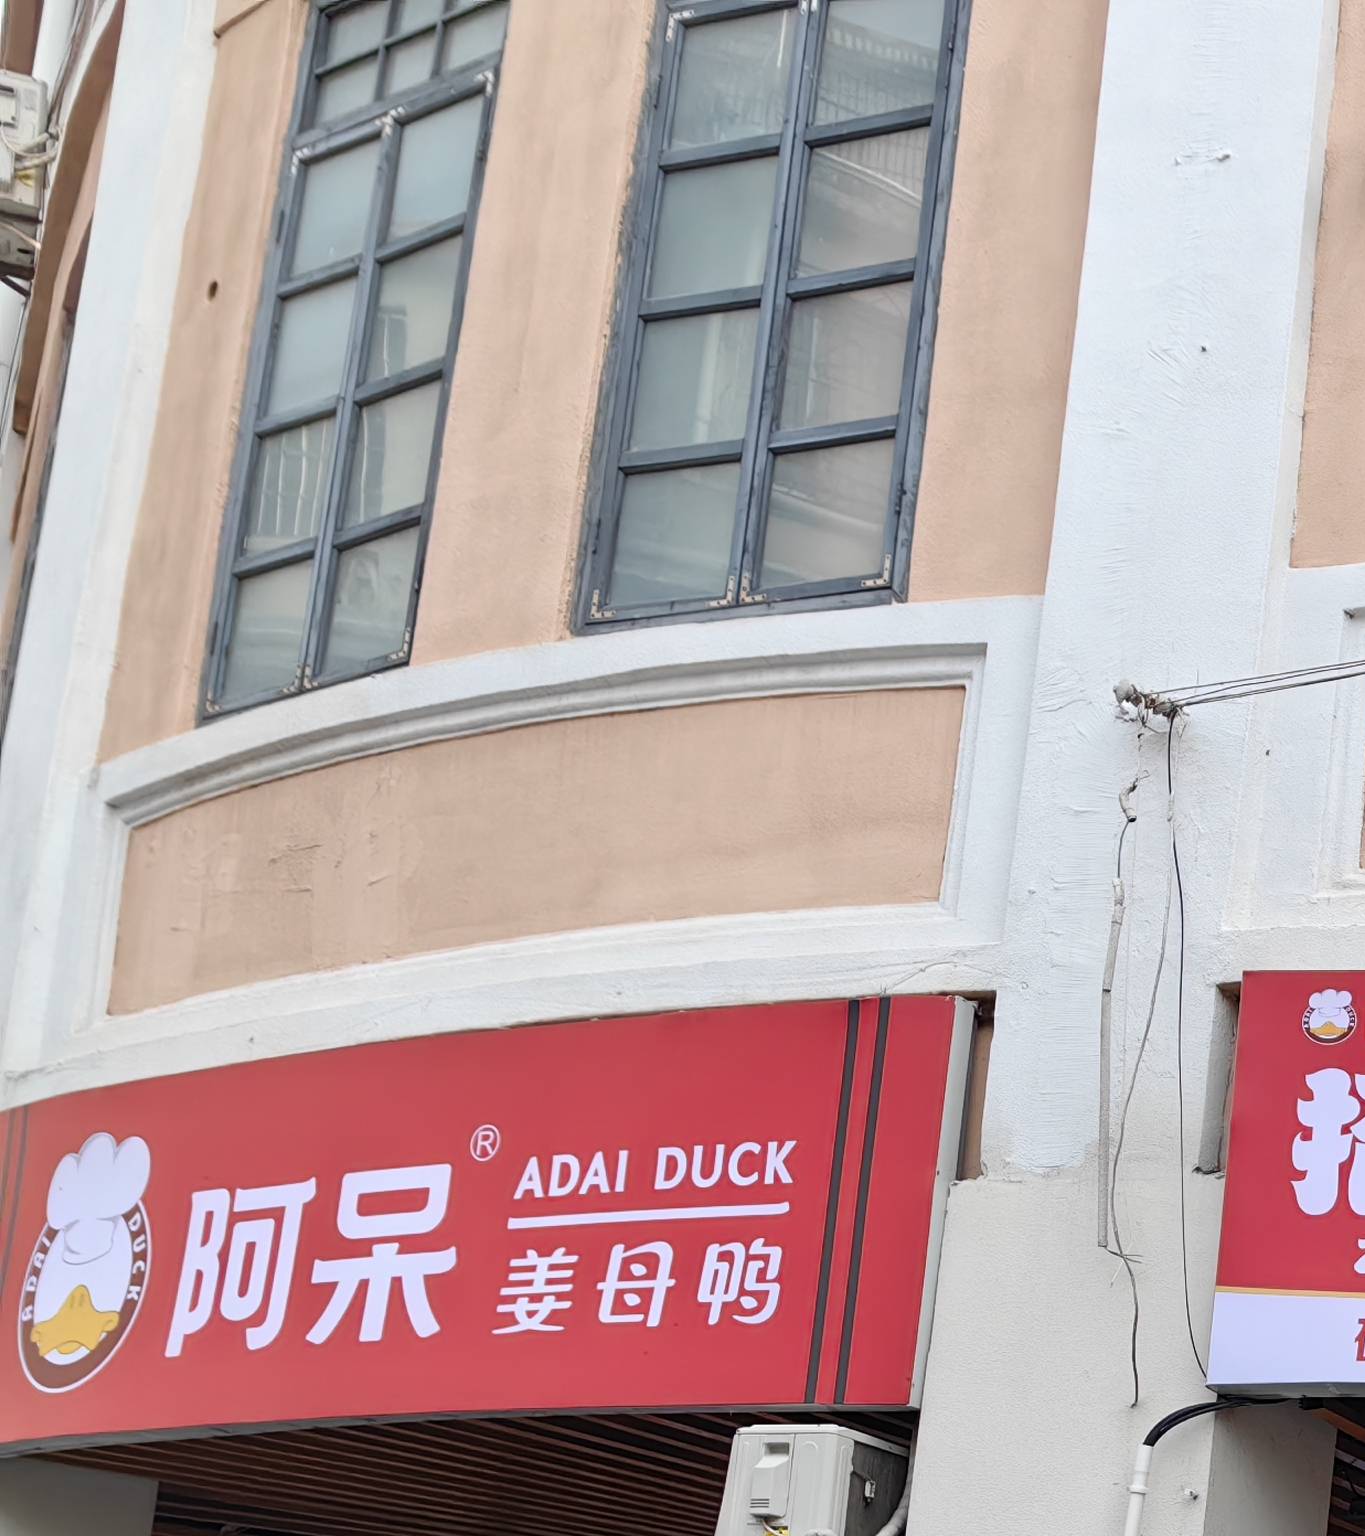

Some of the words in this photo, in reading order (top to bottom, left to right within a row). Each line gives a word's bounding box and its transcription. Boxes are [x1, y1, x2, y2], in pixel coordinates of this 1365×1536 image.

[514, 1150, 629, 1200] ADAI
[653, 1140, 798, 1192] DUCK
[164, 1162, 457, 1359] 阿呆
[491, 1237, 784, 1336] 姜母鸭
